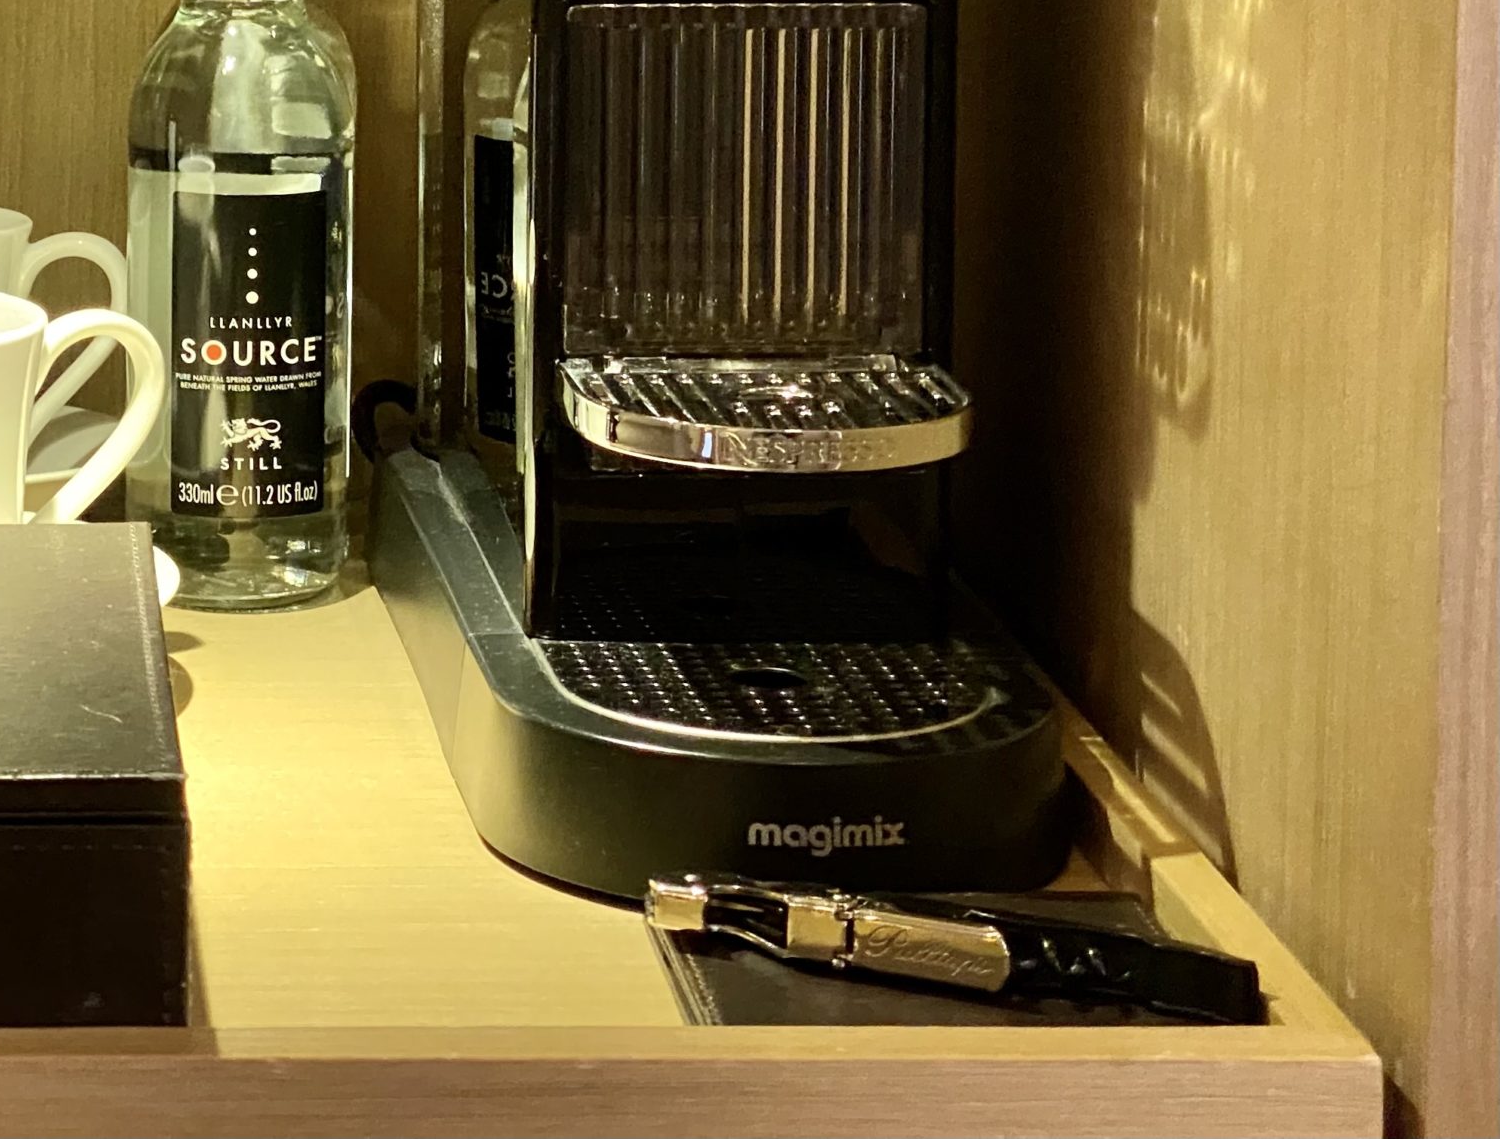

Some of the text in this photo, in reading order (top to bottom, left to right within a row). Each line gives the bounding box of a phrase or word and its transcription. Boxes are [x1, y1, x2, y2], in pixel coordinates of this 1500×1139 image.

[209, 315, 293, 329] LLANLLYR
[180, 336, 317, 366] SOURCE
[175, 372, 191, 381] PURE
[193, 374, 223, 383] NATURAL
[226, 376, 252, 384] SPRING
[255, 375, 278, 383] WATER
[279, 373, 304, 382] DRAWN
[180, 381, 210, 390] BENEATH
[213, 383, 226, 392] THE
[228, 383, 250, 392] FIELDS
[252, 383, 262, 392] OF
[220, 457, 282, 471] STILL
[277, 483, 292, 504] US
[747, 815, 906, 857] magimix
